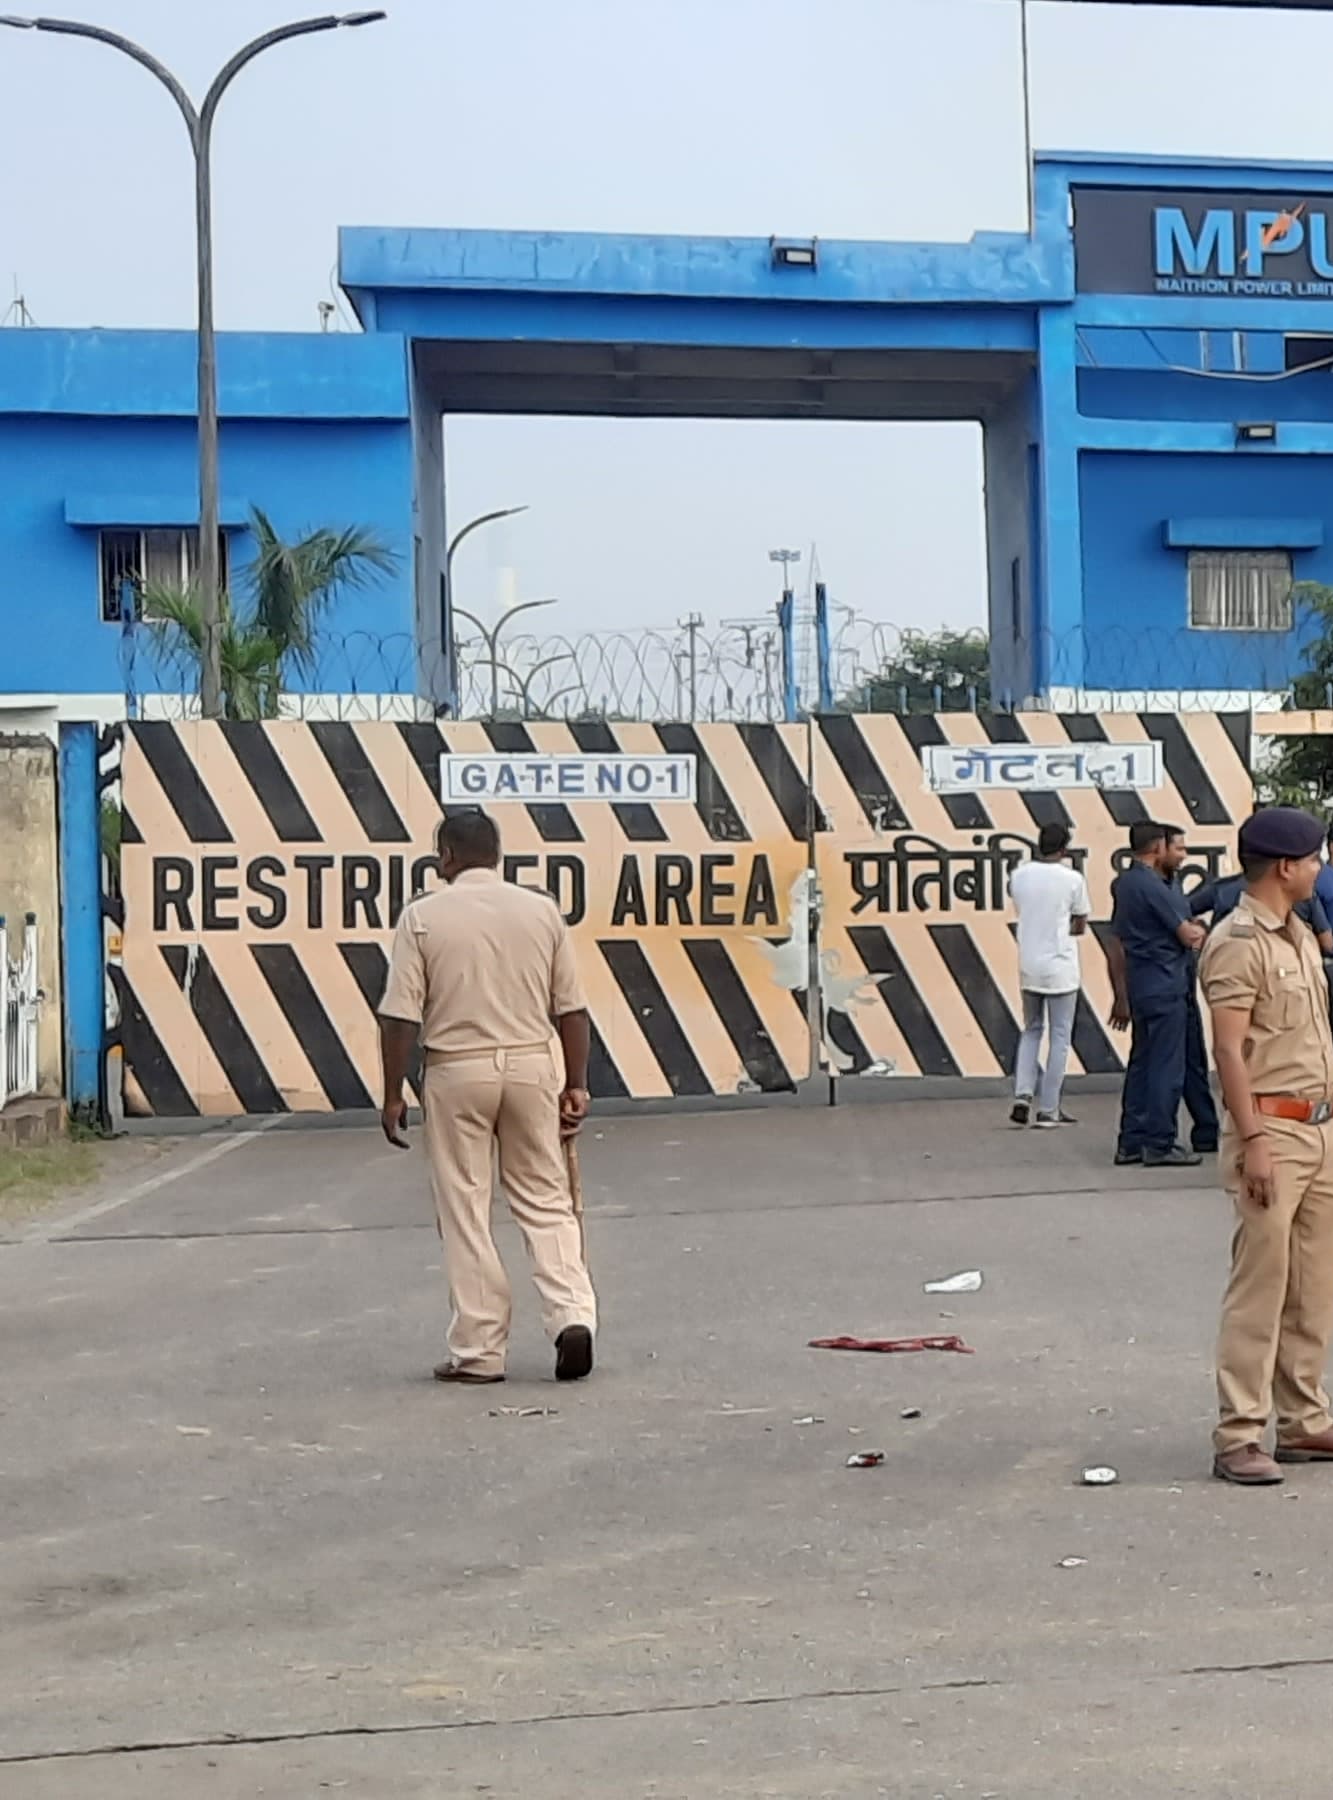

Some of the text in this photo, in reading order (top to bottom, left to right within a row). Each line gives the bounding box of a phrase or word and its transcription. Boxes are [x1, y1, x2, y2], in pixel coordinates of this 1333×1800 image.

[1156, 278, 1229, 294] MAITHON
[1233, 280, 1293, 295] POWER
[461, 763, 585, 794] GATE
[952, 748, 1038, 784] गेट
[610, 854, 779, 926] AREA
